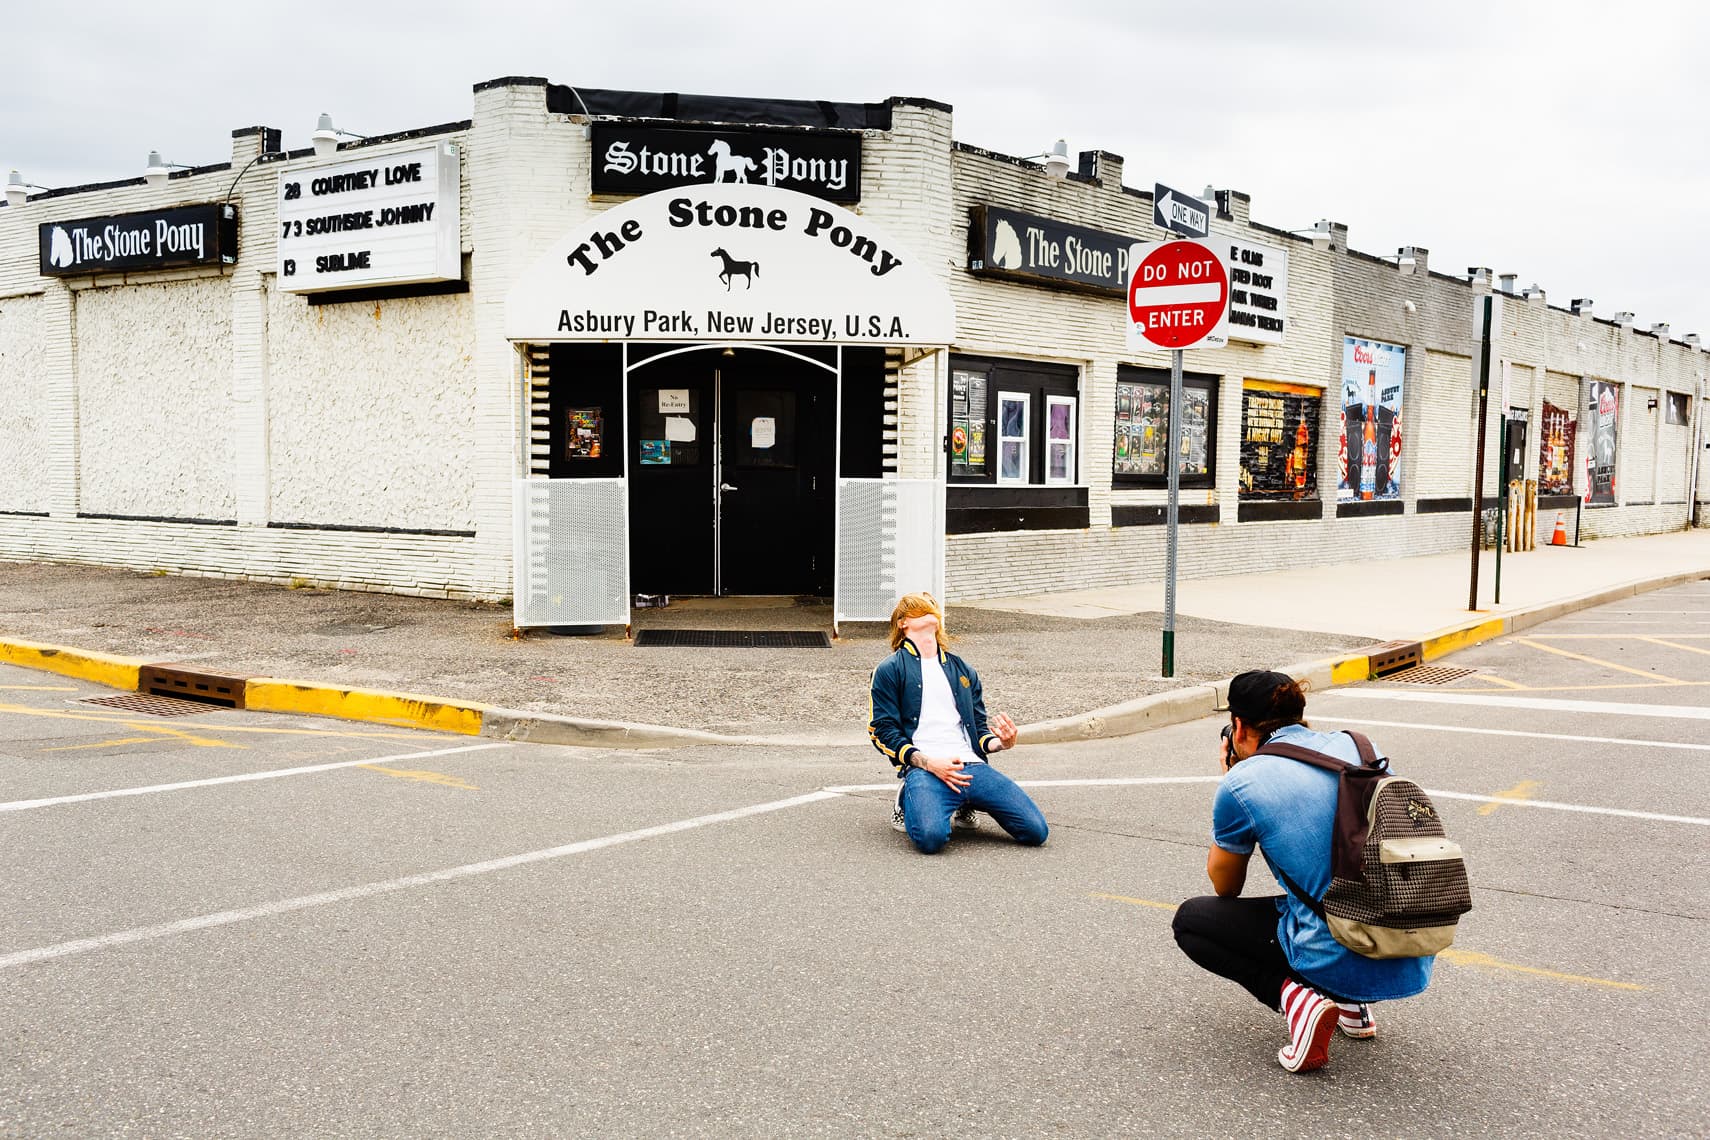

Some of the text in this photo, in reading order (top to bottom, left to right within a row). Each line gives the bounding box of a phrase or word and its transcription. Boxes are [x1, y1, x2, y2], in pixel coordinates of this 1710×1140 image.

[310, 169, 379, 197] COURTNEY
[384, 162, 422, 186] LOVE
[603, 141, 849, 189] Stone Pony
[282, 202, 436, 239] 7 3 SOUTHSIDE JOHNNY
[1171, 203, 1205, 231] ONE WAY
[72, 219, 204, 264] The Stone Pony
[566, 198, 903, 277] The Stone Pony
[1026, 226, 1060, 268] The
[1064, 235, 1112, 279] Stone
[315, 250, 371, 273] SUBLIME
[1143, 260, 1213, 282] DO NOT
[557, 309, 910, 340] Asbury Park, New Jersey, U.S.A.
[1149, 309, 1204, 329] ENTER
